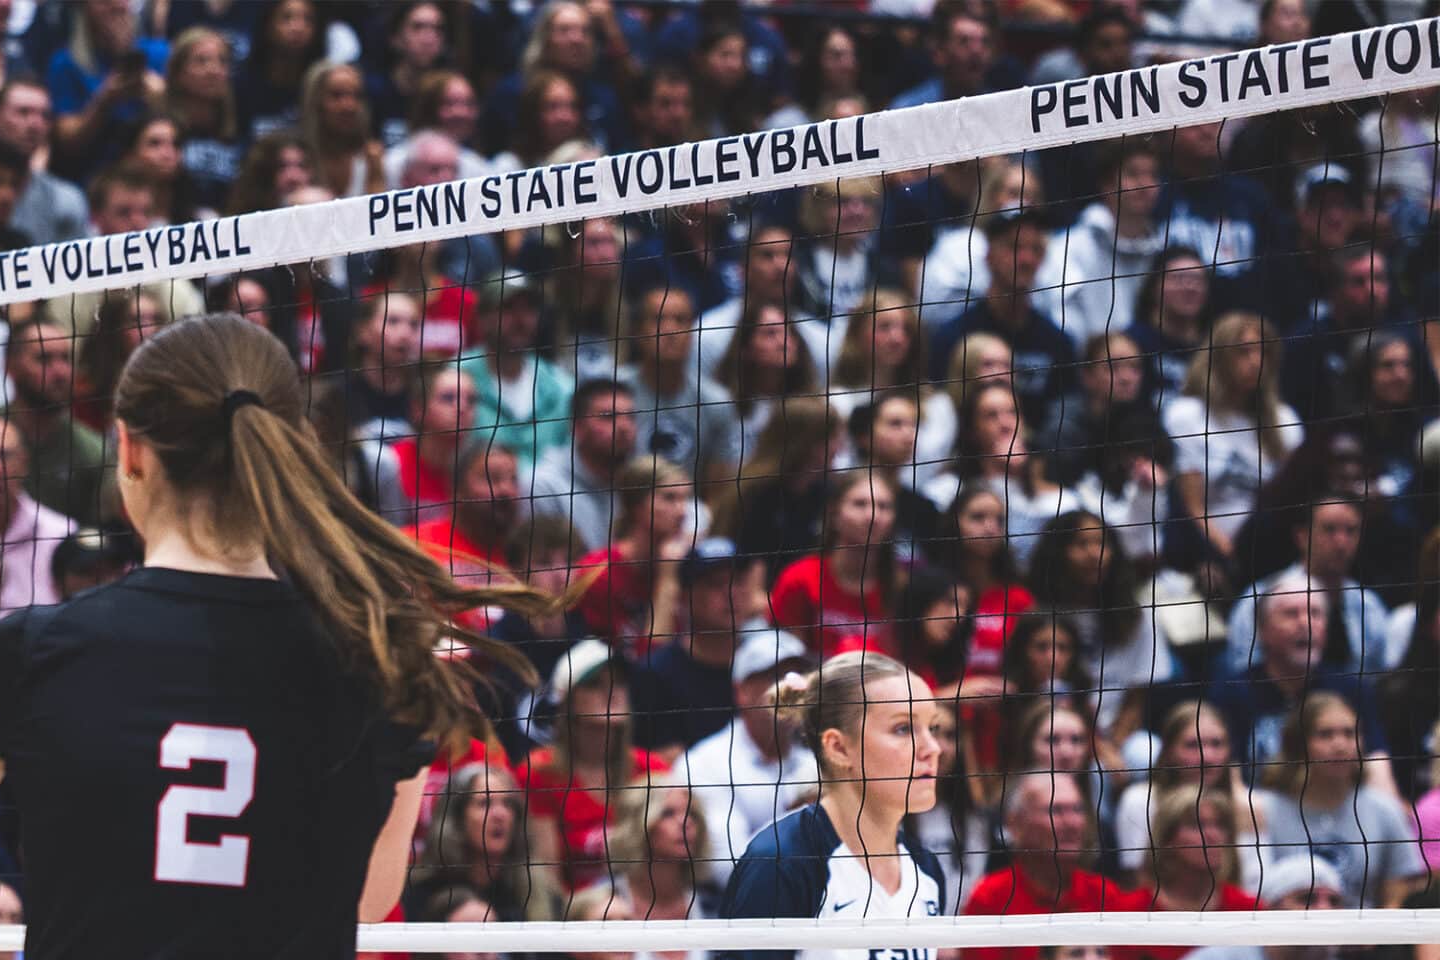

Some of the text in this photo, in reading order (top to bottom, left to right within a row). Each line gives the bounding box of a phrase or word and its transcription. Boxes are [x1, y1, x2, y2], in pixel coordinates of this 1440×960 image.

[1031, 66, 1159, 133] PENN
[1178, 38, 1331, 107] STATE
[369, 116, 879, 235] PENN STATE VOLLEYBALL
[41, 218, 251, 284] VOLLEYBALL
[154, 722, 258, 888] 2
